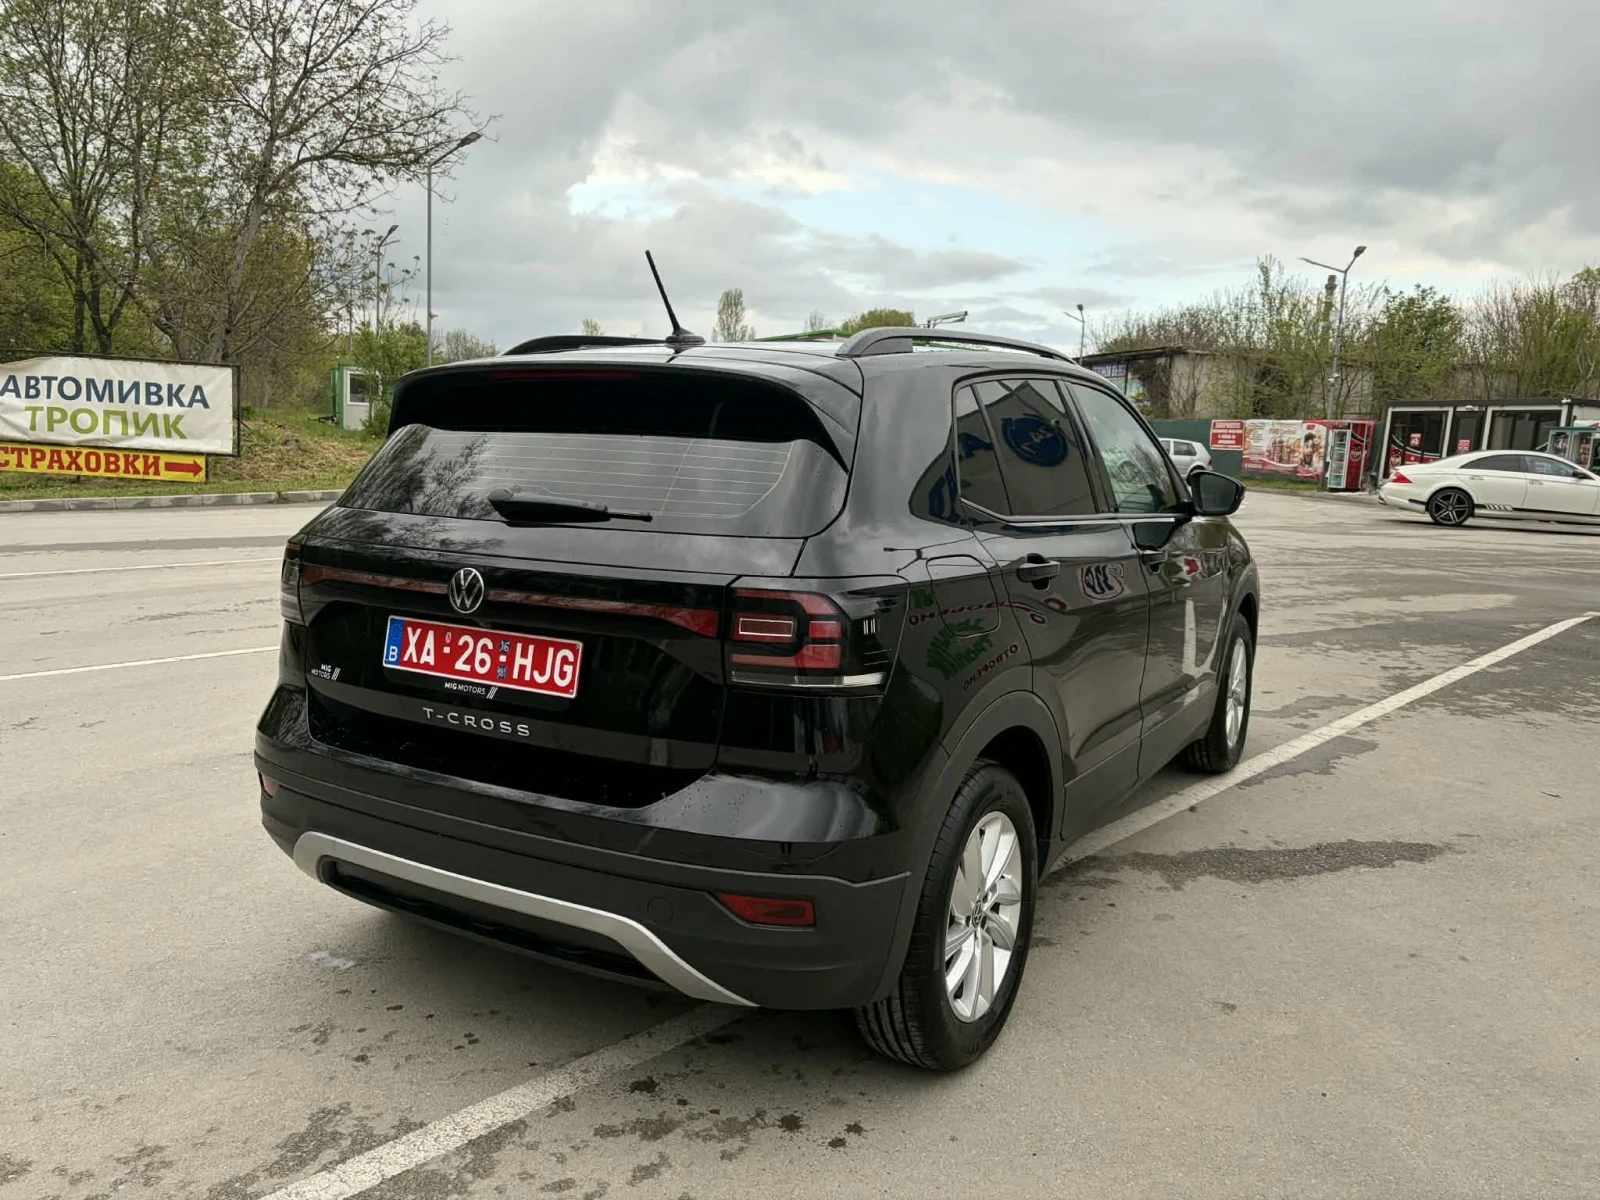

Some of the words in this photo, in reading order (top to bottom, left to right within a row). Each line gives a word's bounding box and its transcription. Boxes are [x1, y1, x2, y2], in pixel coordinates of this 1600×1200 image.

[0, 375, 210, 409] АВТОМИВКА
[25, 406, 188, 440] ТРОПИК
[388, 646, 398, 661] B
[422, 707, 530, 738] T-CROSS
